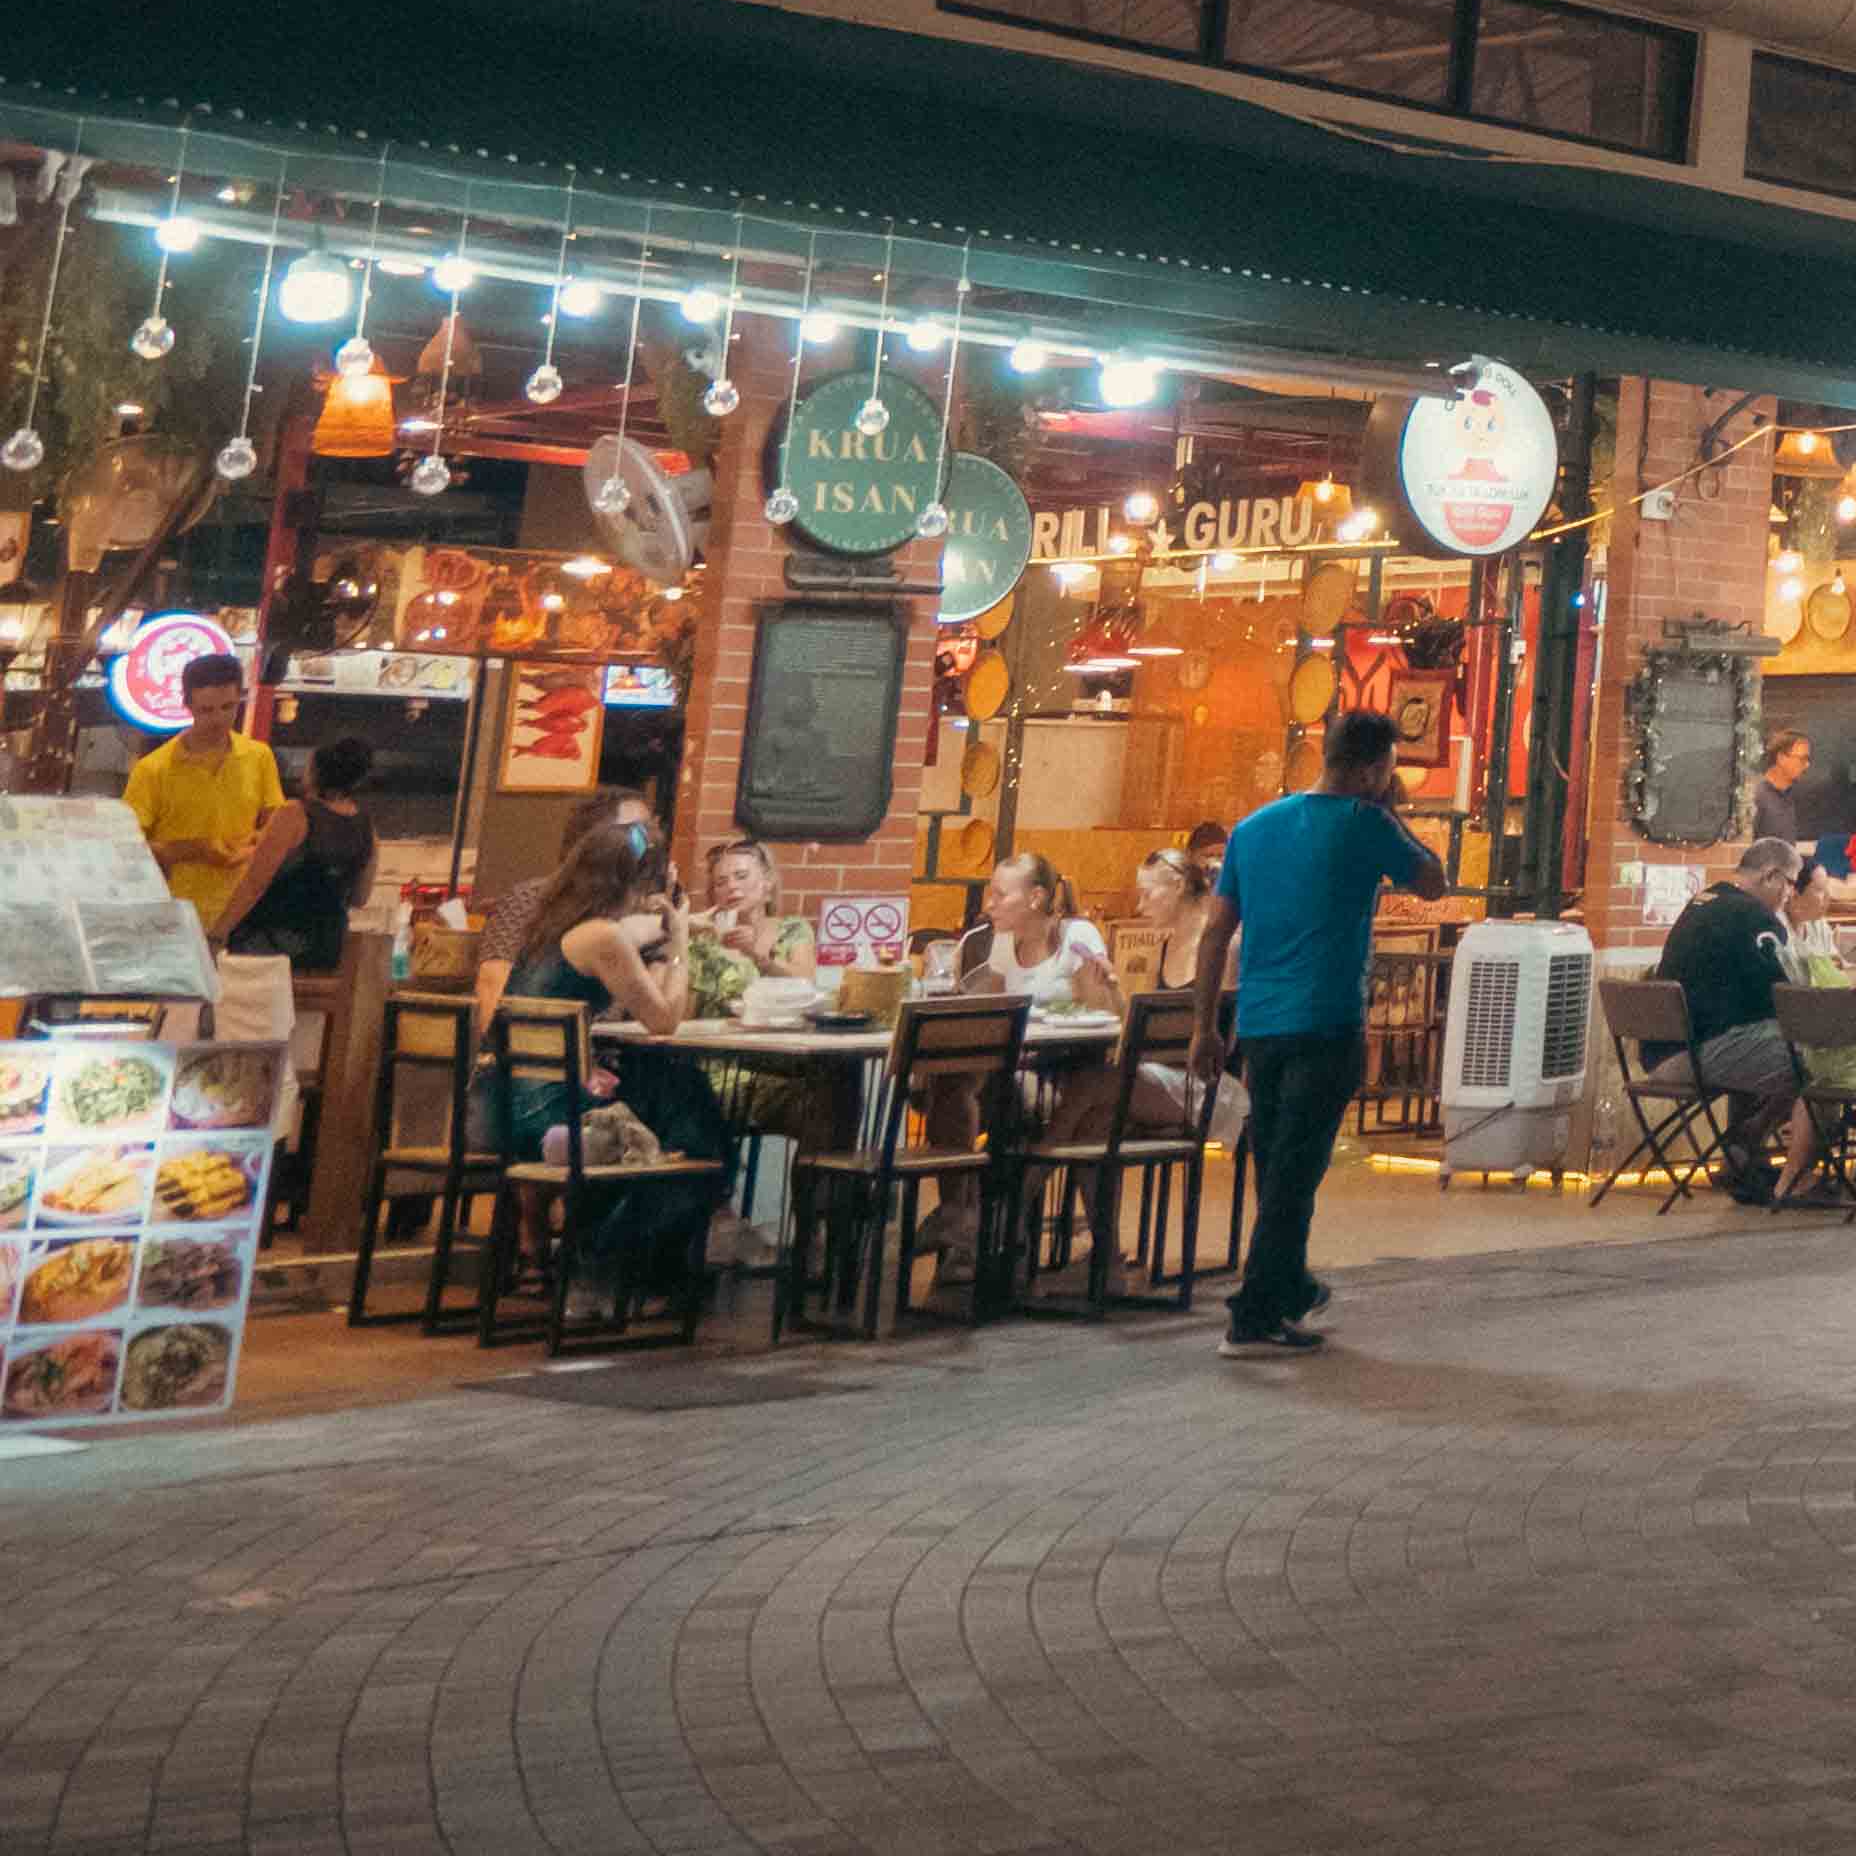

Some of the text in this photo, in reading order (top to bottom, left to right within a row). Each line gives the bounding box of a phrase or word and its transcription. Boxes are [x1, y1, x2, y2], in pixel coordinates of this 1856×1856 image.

[808, 429, 928, 464] KRUA
[814, 480, 918, 513] ISAN
[1031, 494, 1313, 559] RILL GURU
